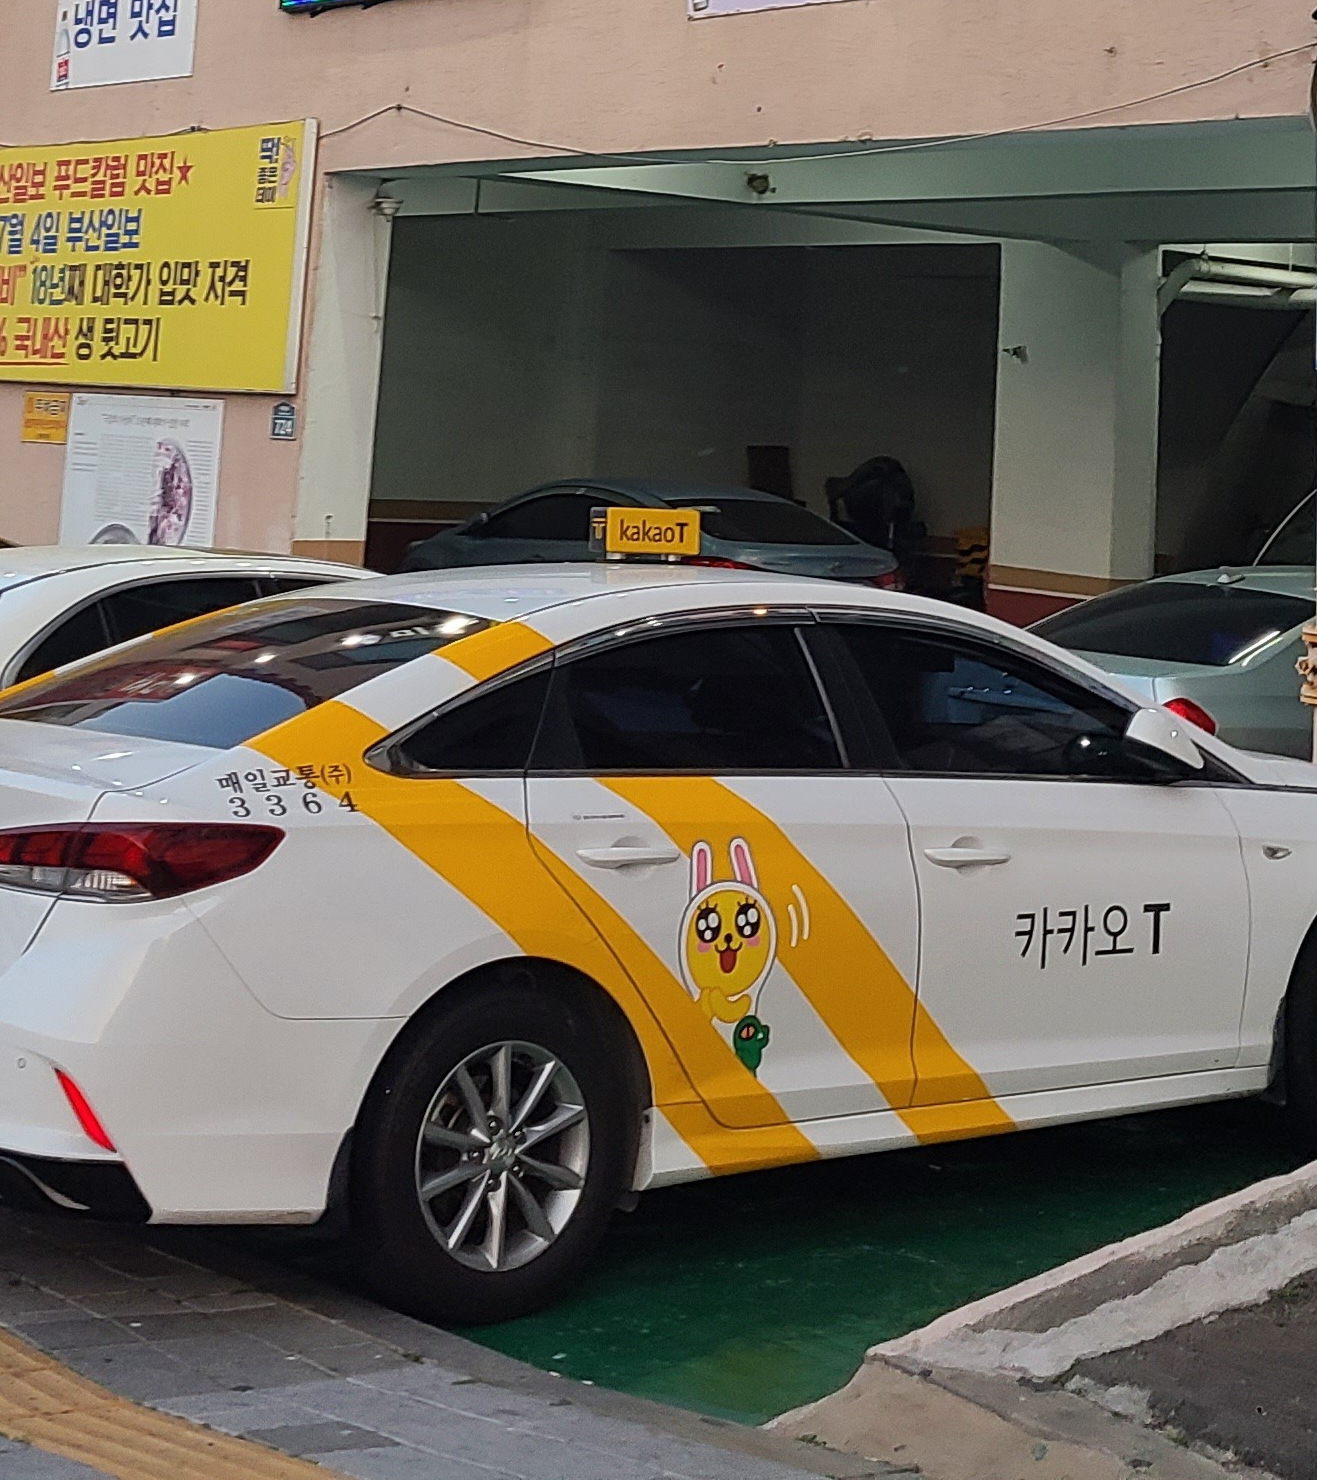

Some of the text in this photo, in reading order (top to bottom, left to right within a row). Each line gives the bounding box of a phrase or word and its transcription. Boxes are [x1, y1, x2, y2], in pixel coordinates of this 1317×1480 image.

[53, 154, 129, 201] 푸드칼럼
[30, 211, 62, 255] 4일
[65, 208, 143, 253] 부산일보
[90, 261, 152, 307] 대학가
[157, 260, 200, 307] 입맛
[204, 259, 250, 306] 저격
[13, 317, 70, 360] 국내산
[75, 317, 95, 361] 생
[100, 317, 161, 362] 뒷고기
[619, 518, 689, 544] kakaoT
[215, 763, 352, 794] 매일교통(주)
